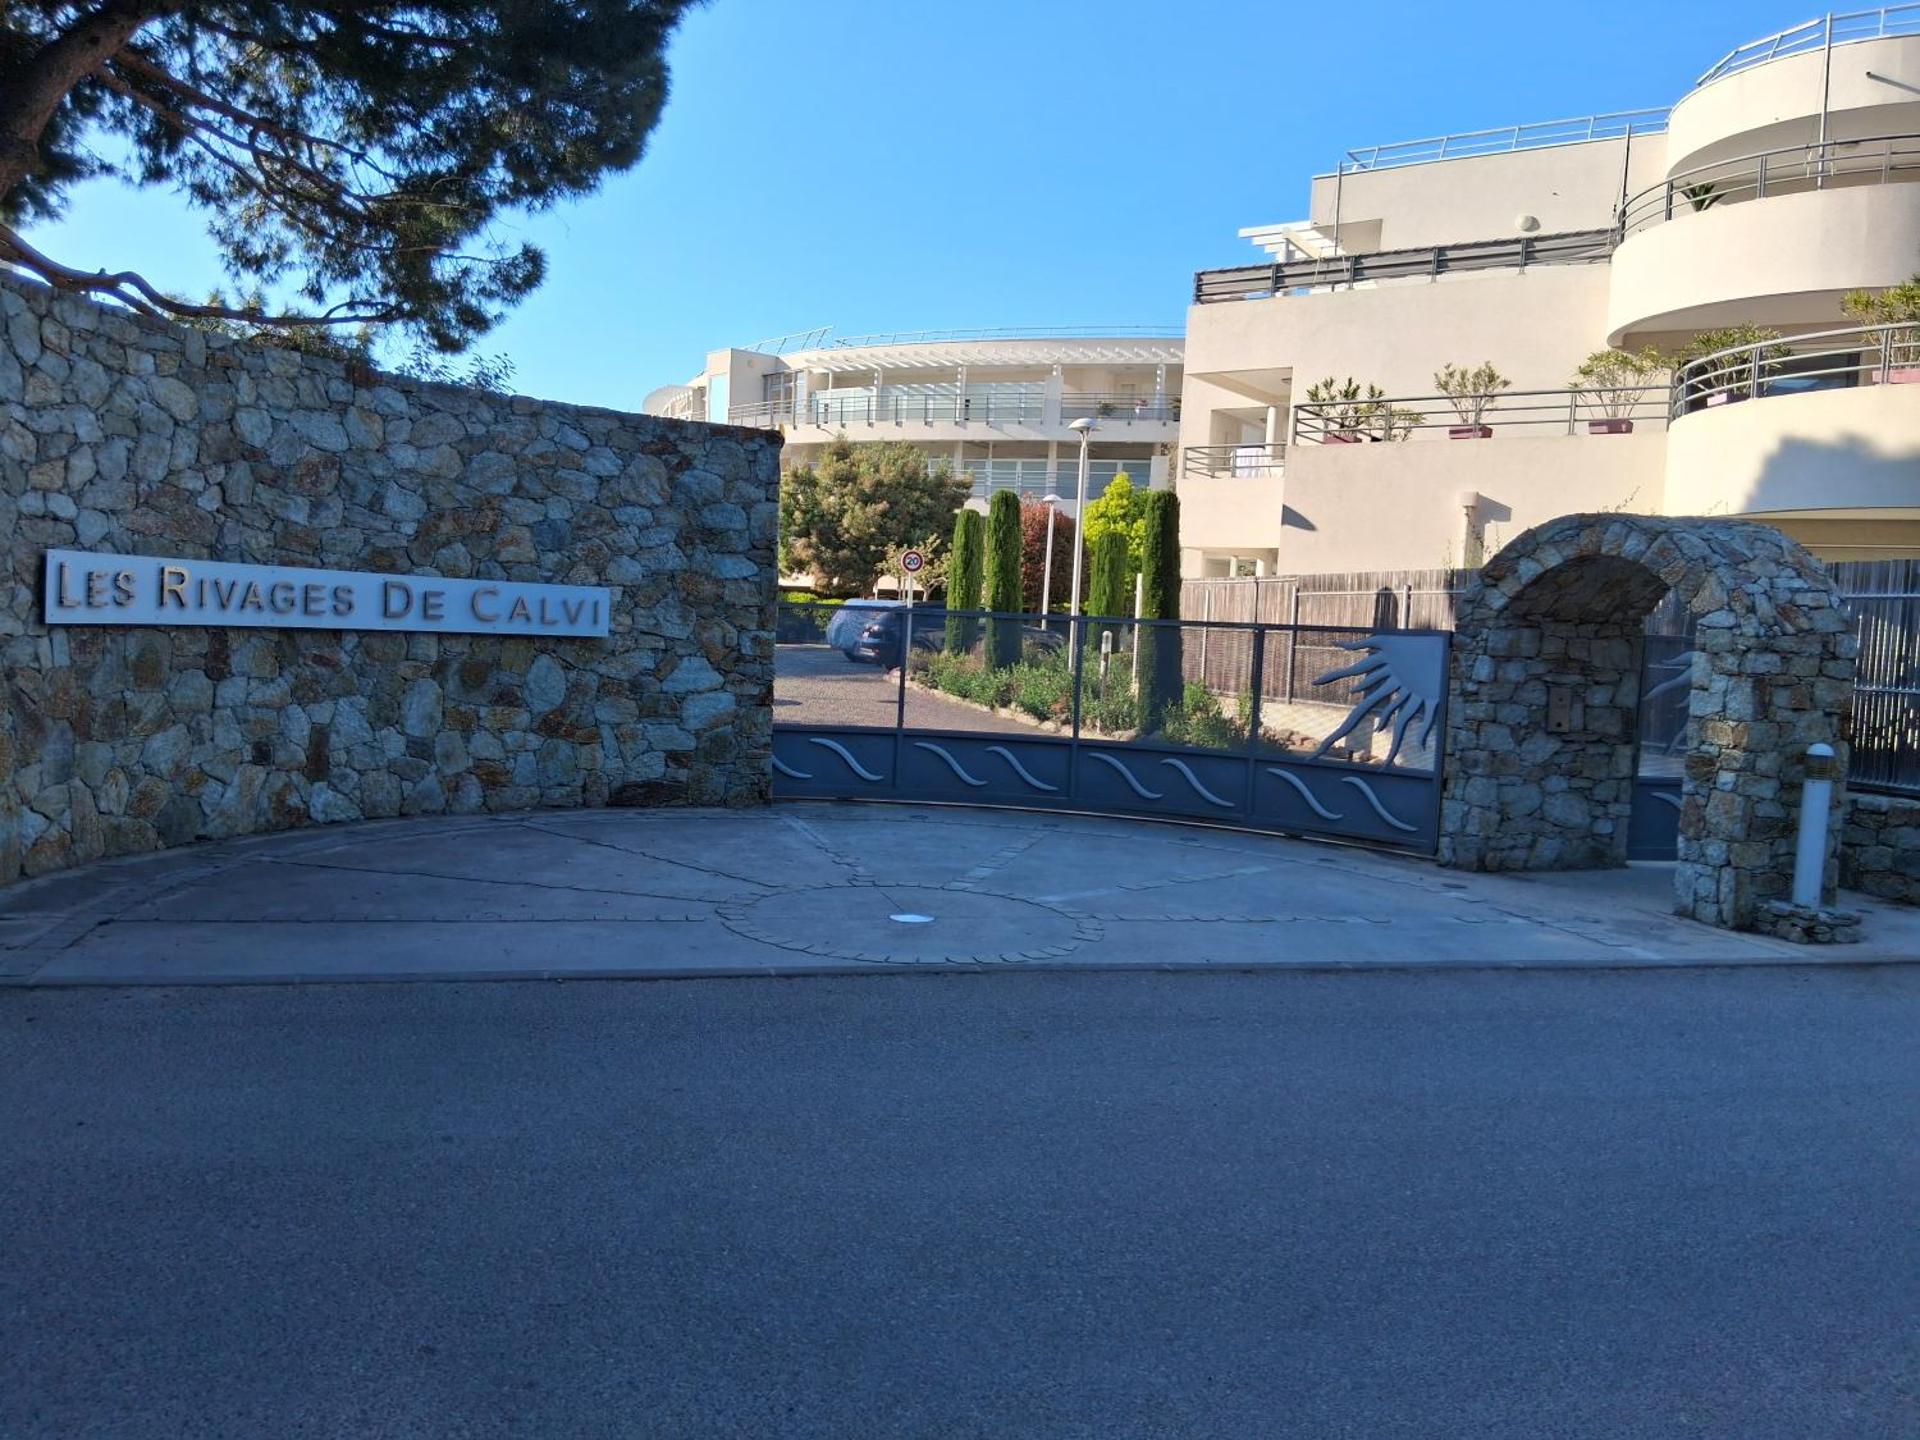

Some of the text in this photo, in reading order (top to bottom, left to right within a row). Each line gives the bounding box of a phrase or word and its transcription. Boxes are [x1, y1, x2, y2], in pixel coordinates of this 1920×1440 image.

[907, 556, 919, 566] 20
[58, 561, 600, 626] LES RIVAGES DE CALVI
